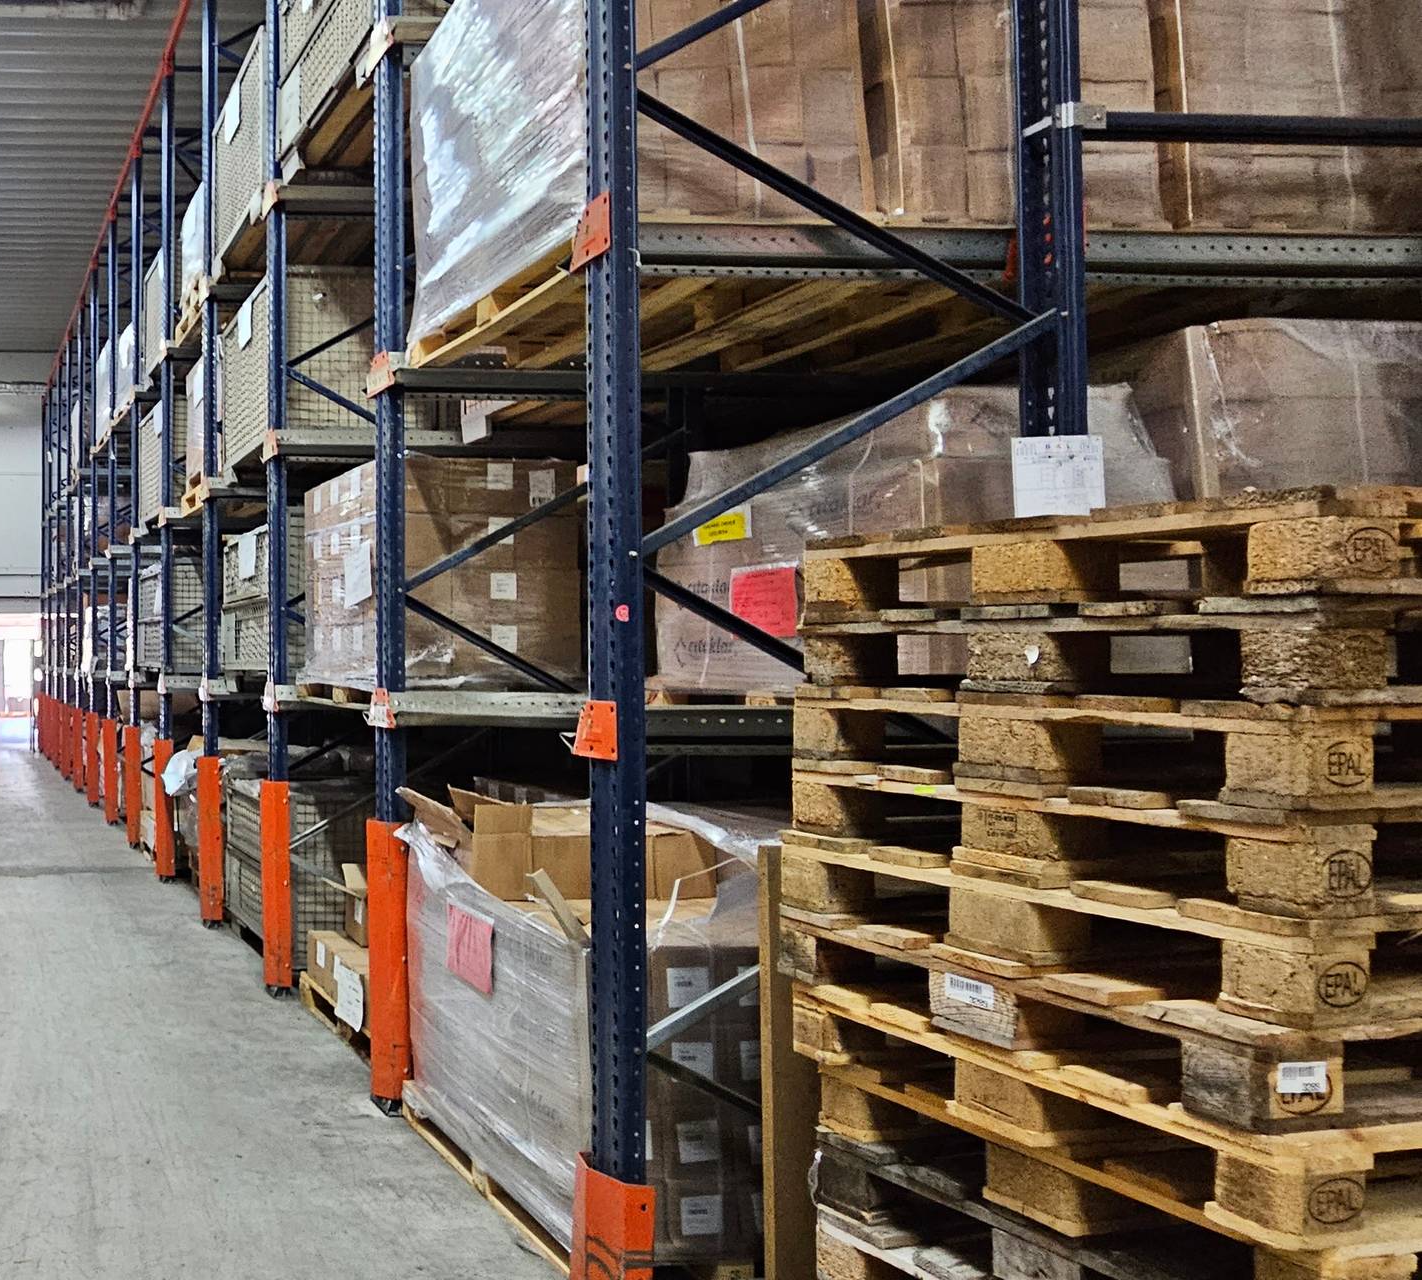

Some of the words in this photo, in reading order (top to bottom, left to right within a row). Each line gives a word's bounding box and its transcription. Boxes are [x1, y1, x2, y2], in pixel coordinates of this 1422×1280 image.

[1327, 751, 1366, 776] EPAL
[1328, 858, 1364, 890] EPAL
[1325, 971, 1360, 998] EPAL
[1316, 1186, 1358, 1216] EPAL
